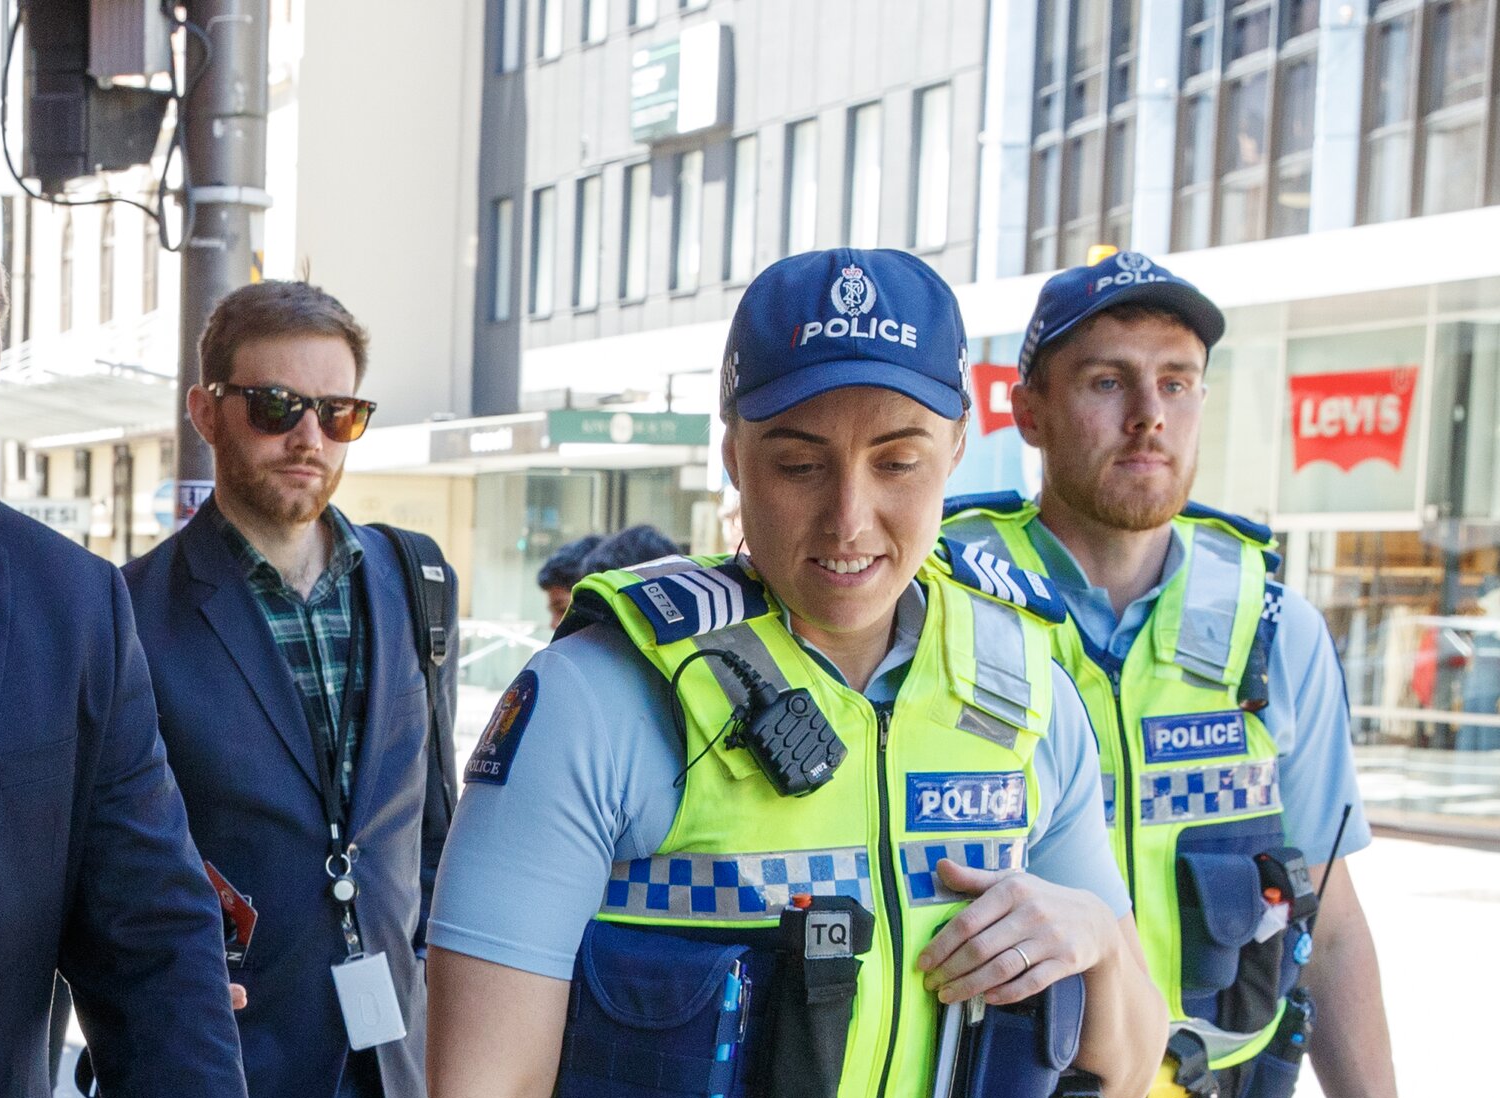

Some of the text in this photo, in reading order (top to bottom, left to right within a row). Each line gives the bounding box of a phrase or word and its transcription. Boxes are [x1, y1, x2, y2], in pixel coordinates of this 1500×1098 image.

[800, 317, 917, 349] POLICE
[647, 585, 678, 618] CF75
[1155, 722, 1241, 750] POLICE
[921, 786, 1023, 818] POLICE
[811, 923, 847, 946] TQ
